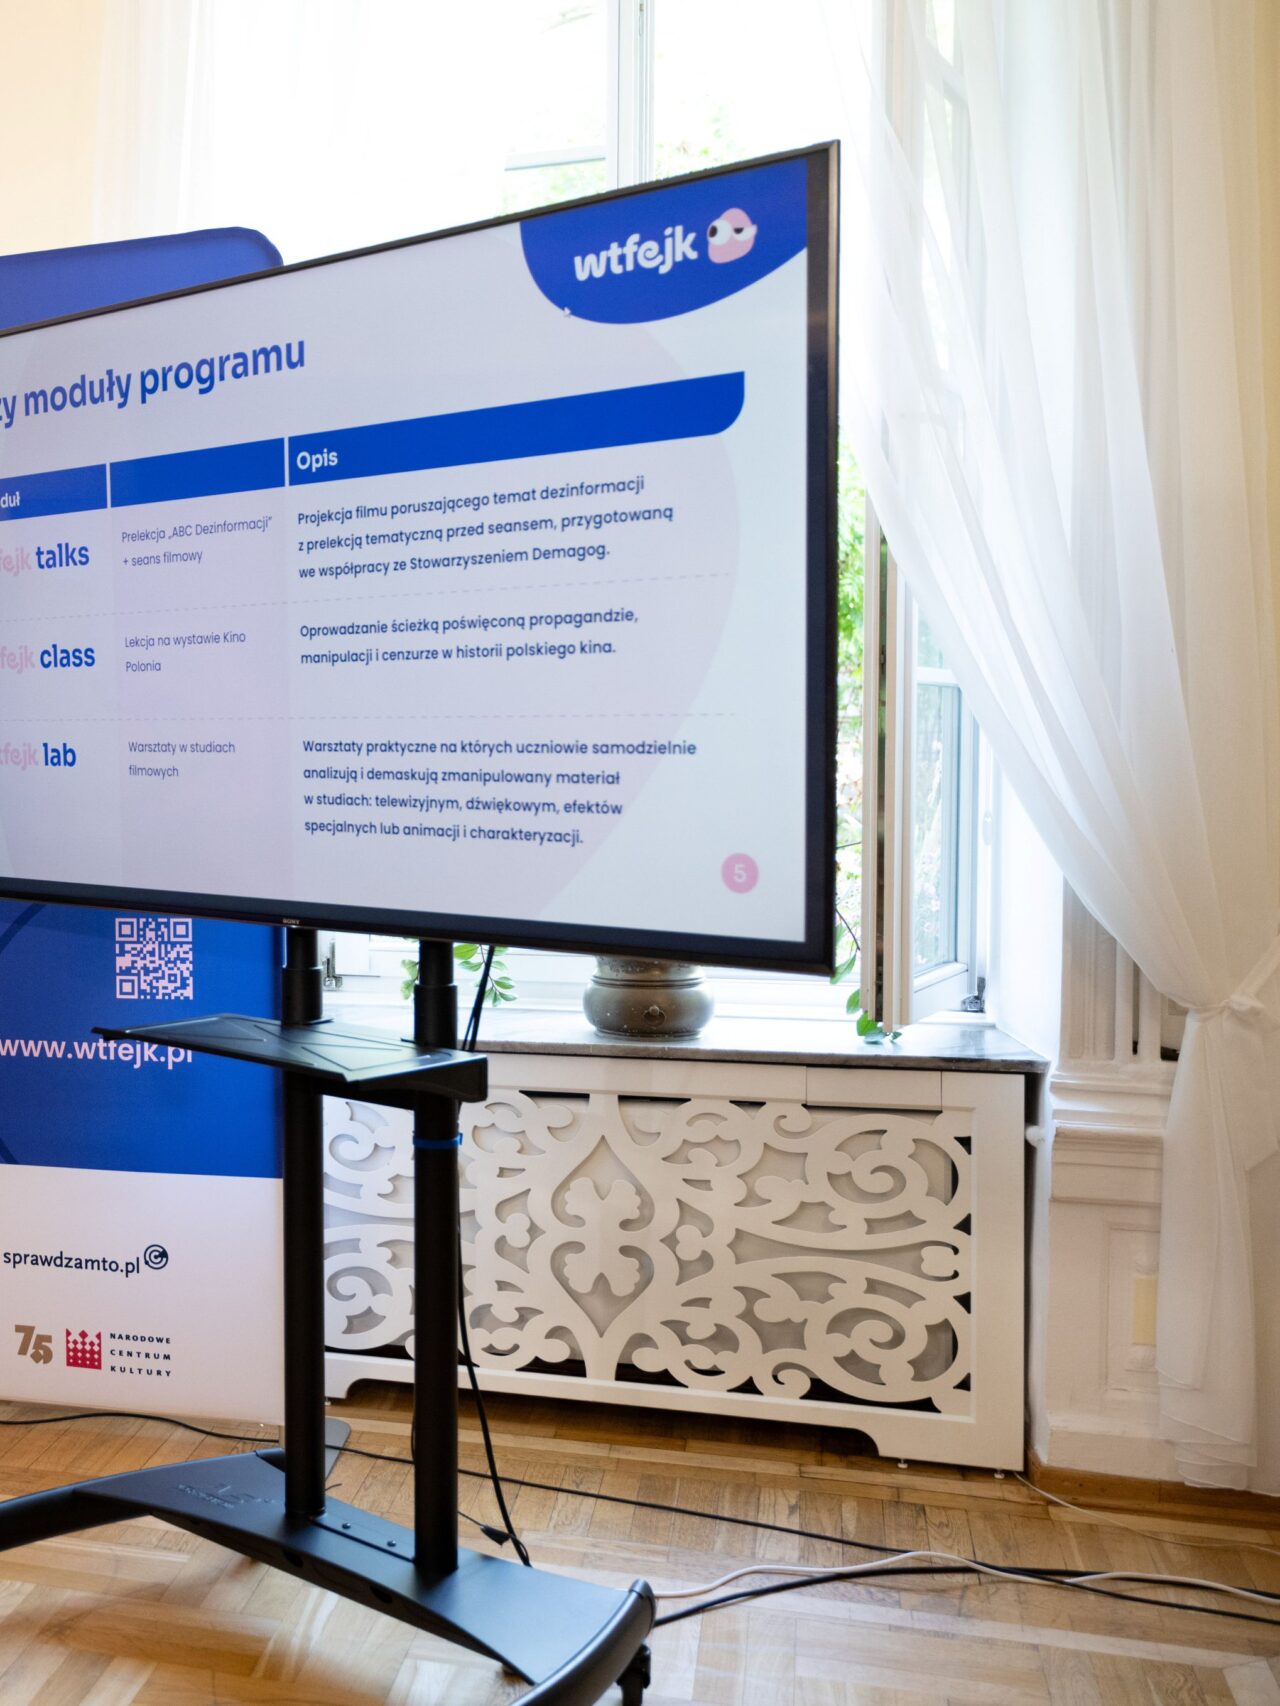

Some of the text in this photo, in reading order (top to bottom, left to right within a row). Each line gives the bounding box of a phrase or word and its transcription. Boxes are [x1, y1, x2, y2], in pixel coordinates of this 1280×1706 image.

[573, 224, 698, 281] wtfejk
[24, 368, 132, 417] moduły
[140, 340, 305, 404] programu
[296, 448, 338, 472] Opis
[297, 475, 645, 527] Projekcja filmu poruszającego temat dezinformacji
[122, 529, 166, 543] Prelekcja
[298, 507, 674, 554] z prelekcją tematyczną przed seansem, przygotowaną
[36, 542, 90, 570] talks
[132, 555, 161, 567] seans
[163, 551, 203, 564] filmowy
[299, 544, 610, 579] we współpracy ze Stowarzyszeniem Demagog.
[300, 607, 638, 640] Oprowadzanie ścieżką poświęconą propagandzie,
[125, 631, 246, 650] Lekcja na wystawie Kino
[40, 643, 95, 668] class
[301, 640, 616, 667] manipulacji i cenzurze w historii polskiego kina.
[125, 660, 161, 672] Polonia
[42, 742, 76, 767] lab
[128, 741, 236, 756] Warsztaty w studiach
[303, 740, 697, 757] Warsztaty praktyczne na których uczniowie samodzielnie
[128, 765, 179, 780] filmowych
[303, 767, 621, 787] analizują i demaskują zmanipulowany materiał
[304, 793, 623, 816] w studiach: telewizyjnym, dźwiękowym, efektów
[304, 820, 584, 847] specjalnych lub animacji i charakteryzacji.
[733, 863, 747, 883] 5
[3, 1251, 140, 1278] sprawdzamto.pl
[14, 1324, 54, 1364] 75
[110, 1333, 171, 1344] NARODOWE
[110, 1349, 171, 1360] CENTRUM
[110, 1366, 171, 1377] KULTURY
